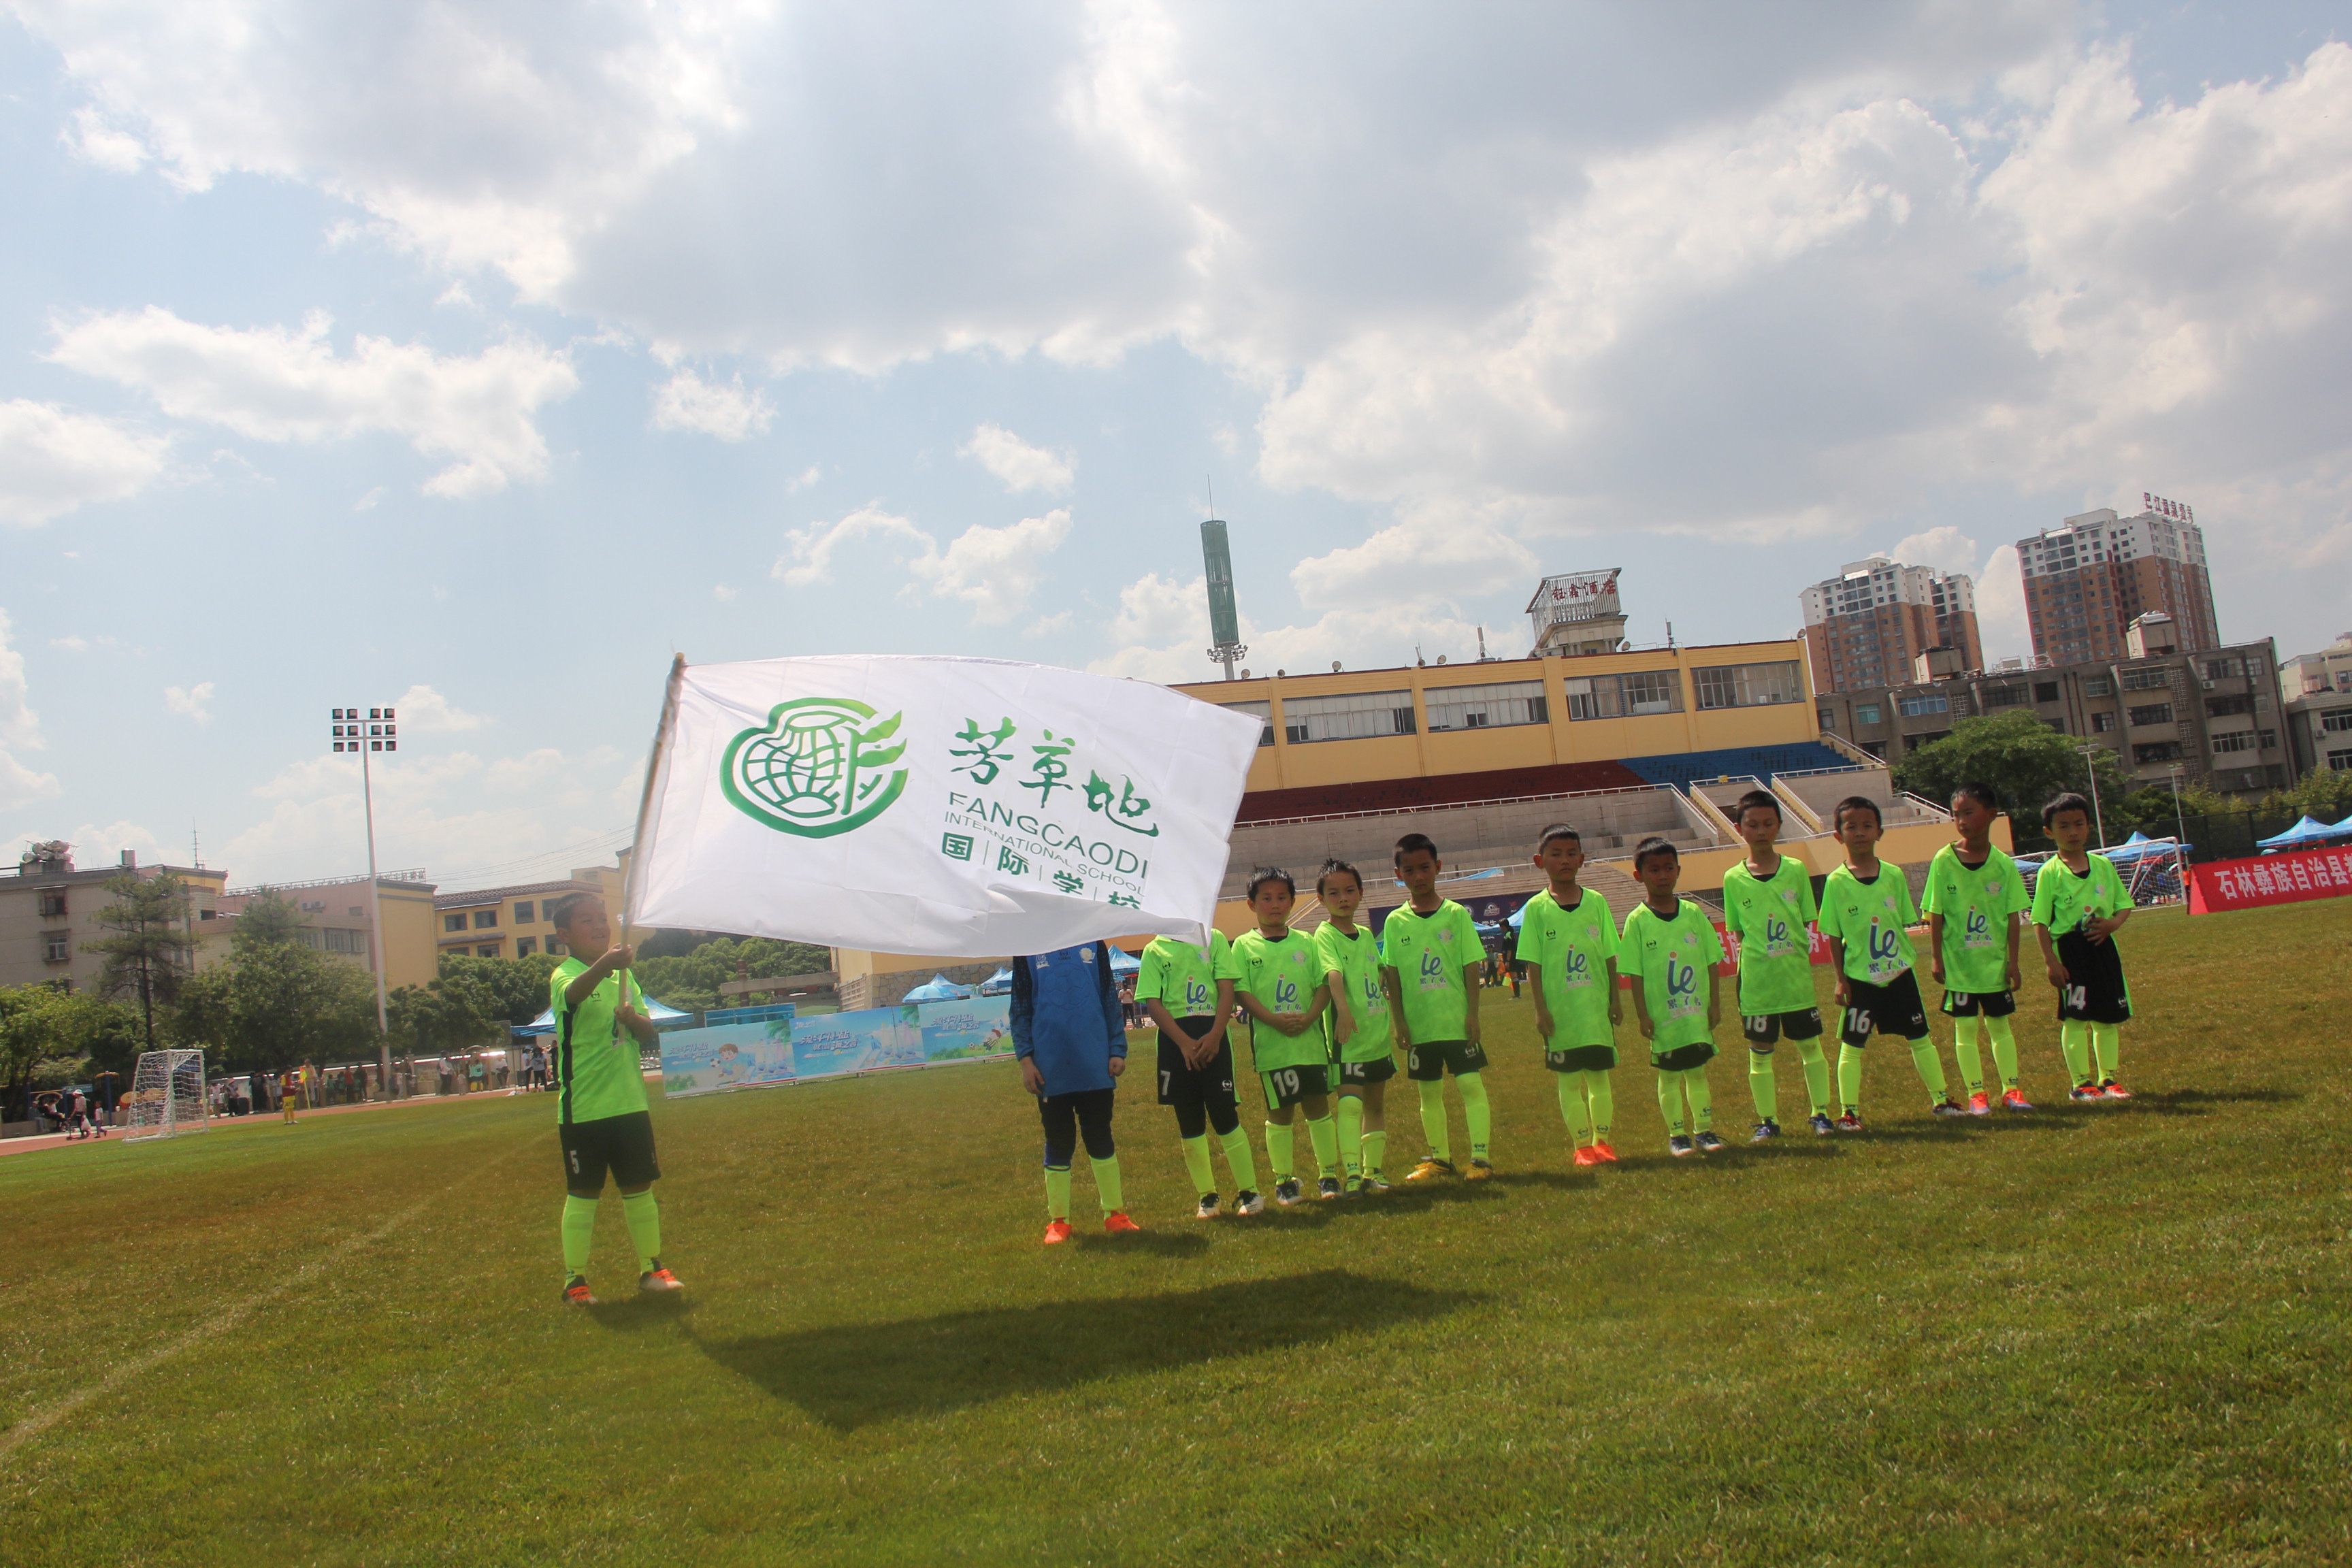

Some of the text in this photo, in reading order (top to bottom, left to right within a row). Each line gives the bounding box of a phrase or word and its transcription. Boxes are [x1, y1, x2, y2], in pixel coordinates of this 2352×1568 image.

[949, 717, 1159, 837] 芳草地
[949, 791, 1148, 879] FANGCAODI
[945, 811, 1145, 897] INTERNATIONAL SCHOOL
[2066, 983, 2086, 1010] 14
[1746, 1015, 1767, 1032] 18
[1848, 1008, 1870, 1034] 16
[1409, 1047, 1420, 1071] 6
[1160, 1071, 1171, 1096] 7
[1273, 1069, 1300, 1097] 19
[570, 1149, 580, 1174] 5
